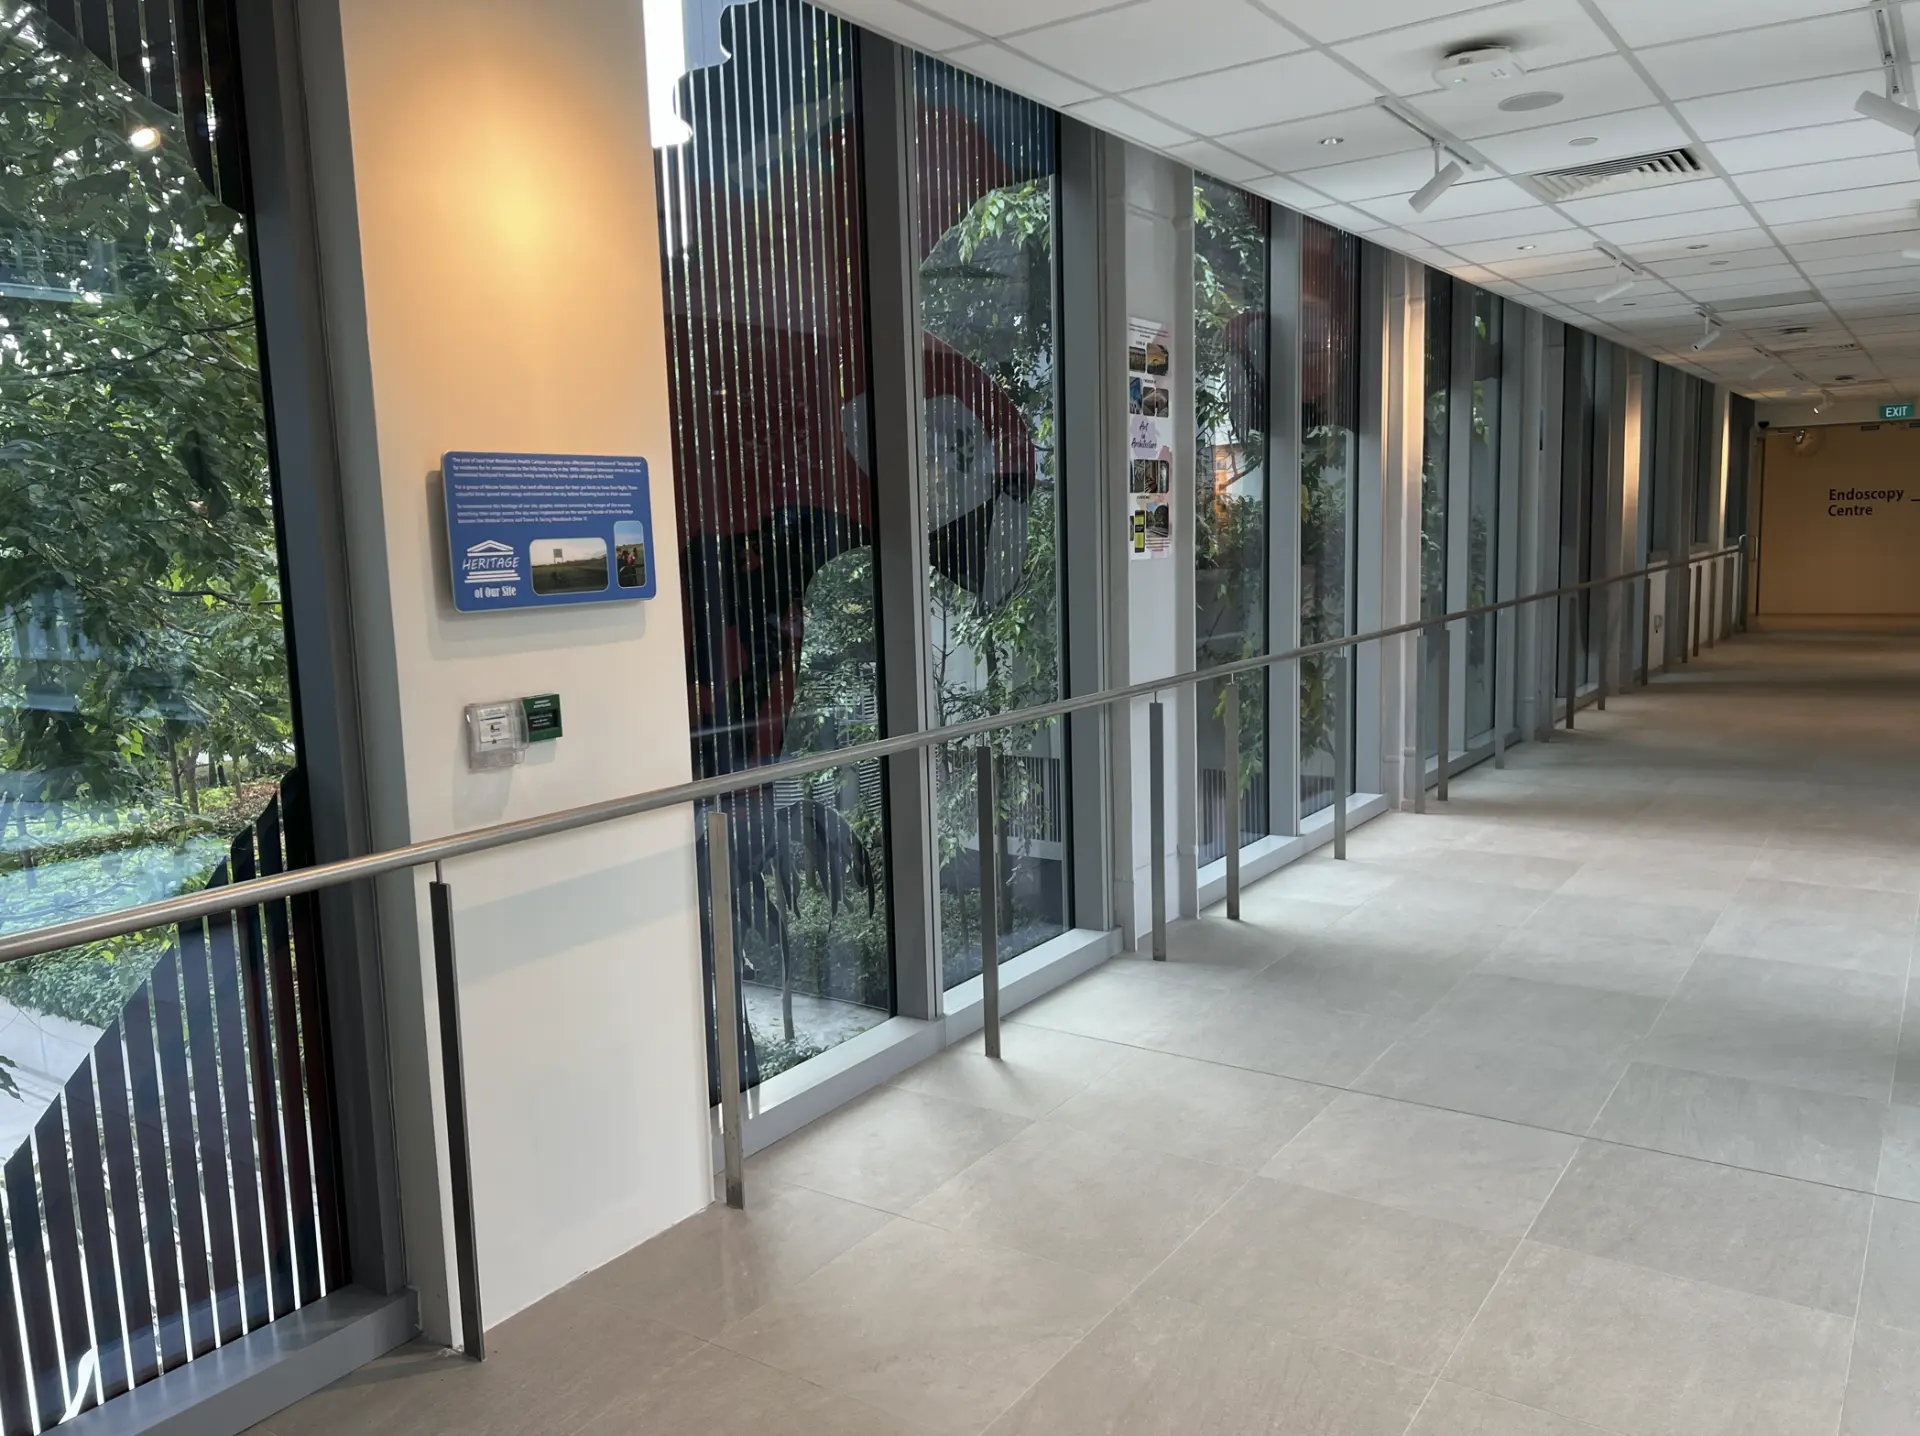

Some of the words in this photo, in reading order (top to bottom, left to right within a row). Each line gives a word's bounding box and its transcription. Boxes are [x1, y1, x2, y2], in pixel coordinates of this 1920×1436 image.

[1885, 406, 1908, 417] EXIT
[1139, 420, 1149, 431] Art
[1829, 488, 1904, 502] Endoscopy
[1828, 505, 1873, 516] Centre
[462, 557, 520, 571] HERITAGE
[474, 586, 483, 598] of
[485, 587, 501, 598] Our
[502, 585, 517, 597] Site
